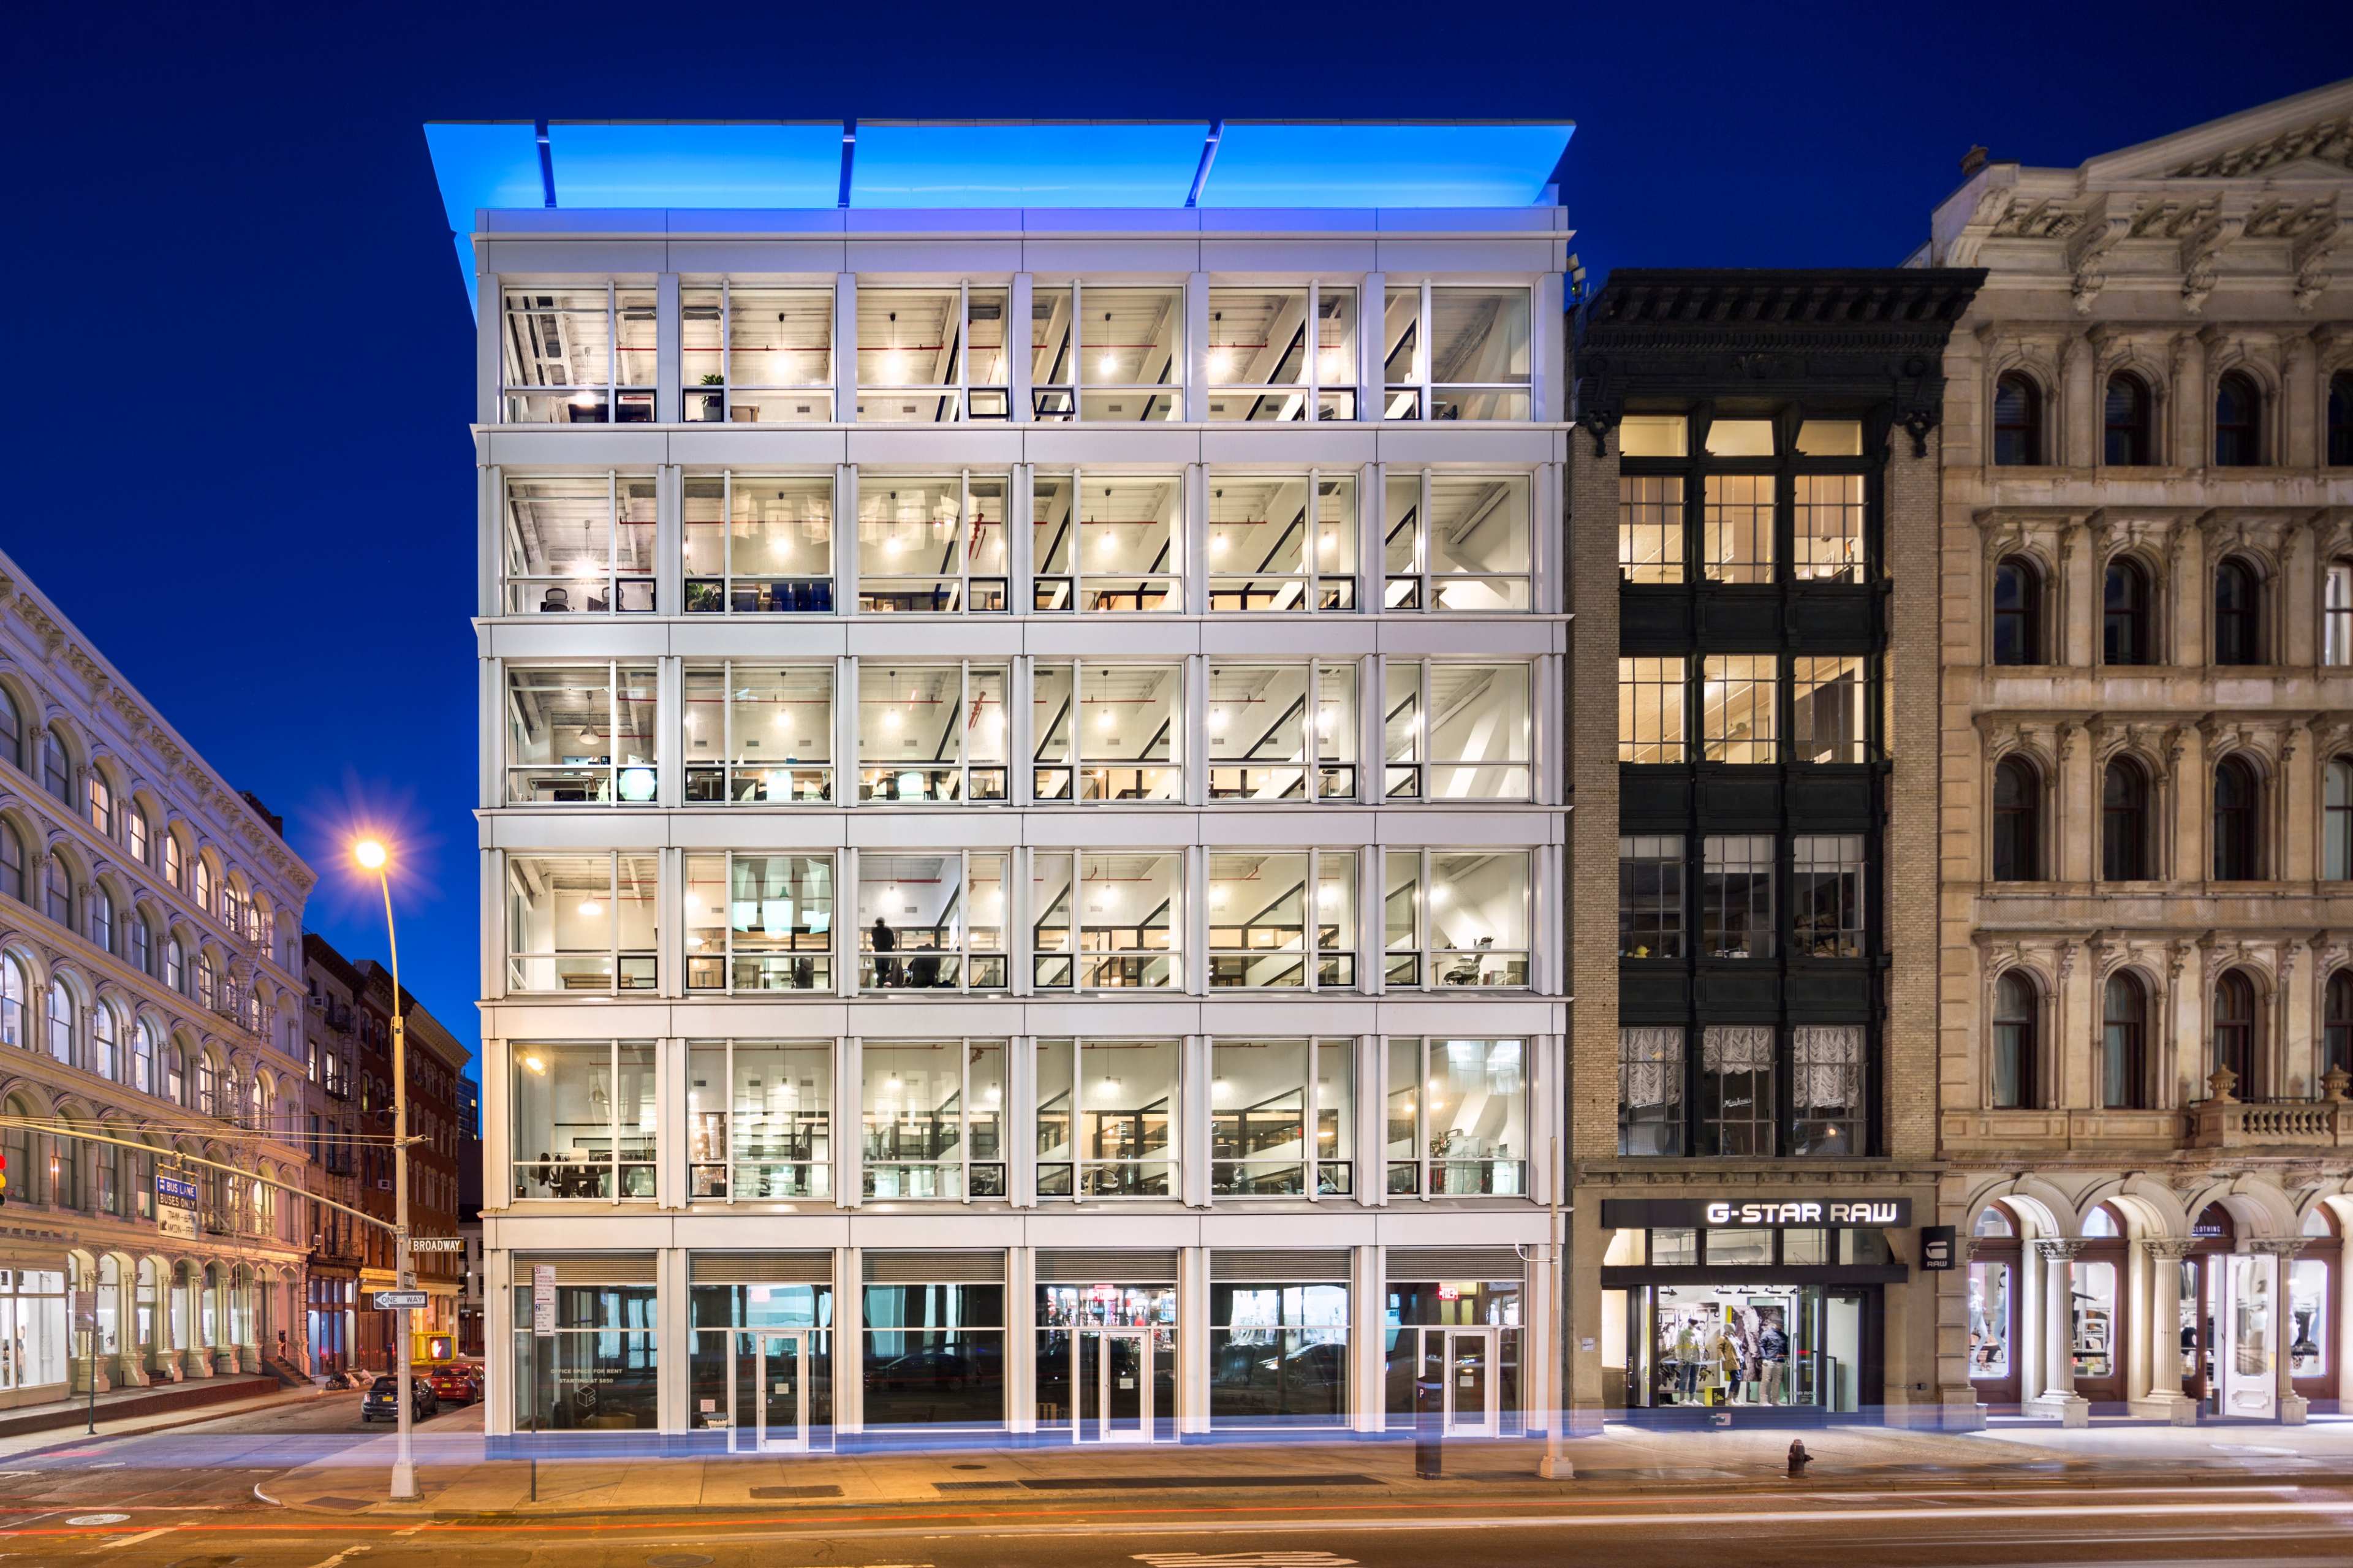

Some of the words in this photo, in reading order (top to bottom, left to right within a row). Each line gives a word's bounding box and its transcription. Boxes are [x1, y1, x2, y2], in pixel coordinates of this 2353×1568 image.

[167, 1182, 178, 1192] BUS
[180, 1185, 195, 1197] LANE
[160, 1194, 180, 1206] BUSES
[181, 1198, 195, 1210] ONLY
[1707, 1203, 1822, 1223] G-STAR
[1830, 1203, 1896, 1222] RAW
[414, 1240, 461, 1251] BROADWAY
[1419, 1388, 1424, 1398] P
